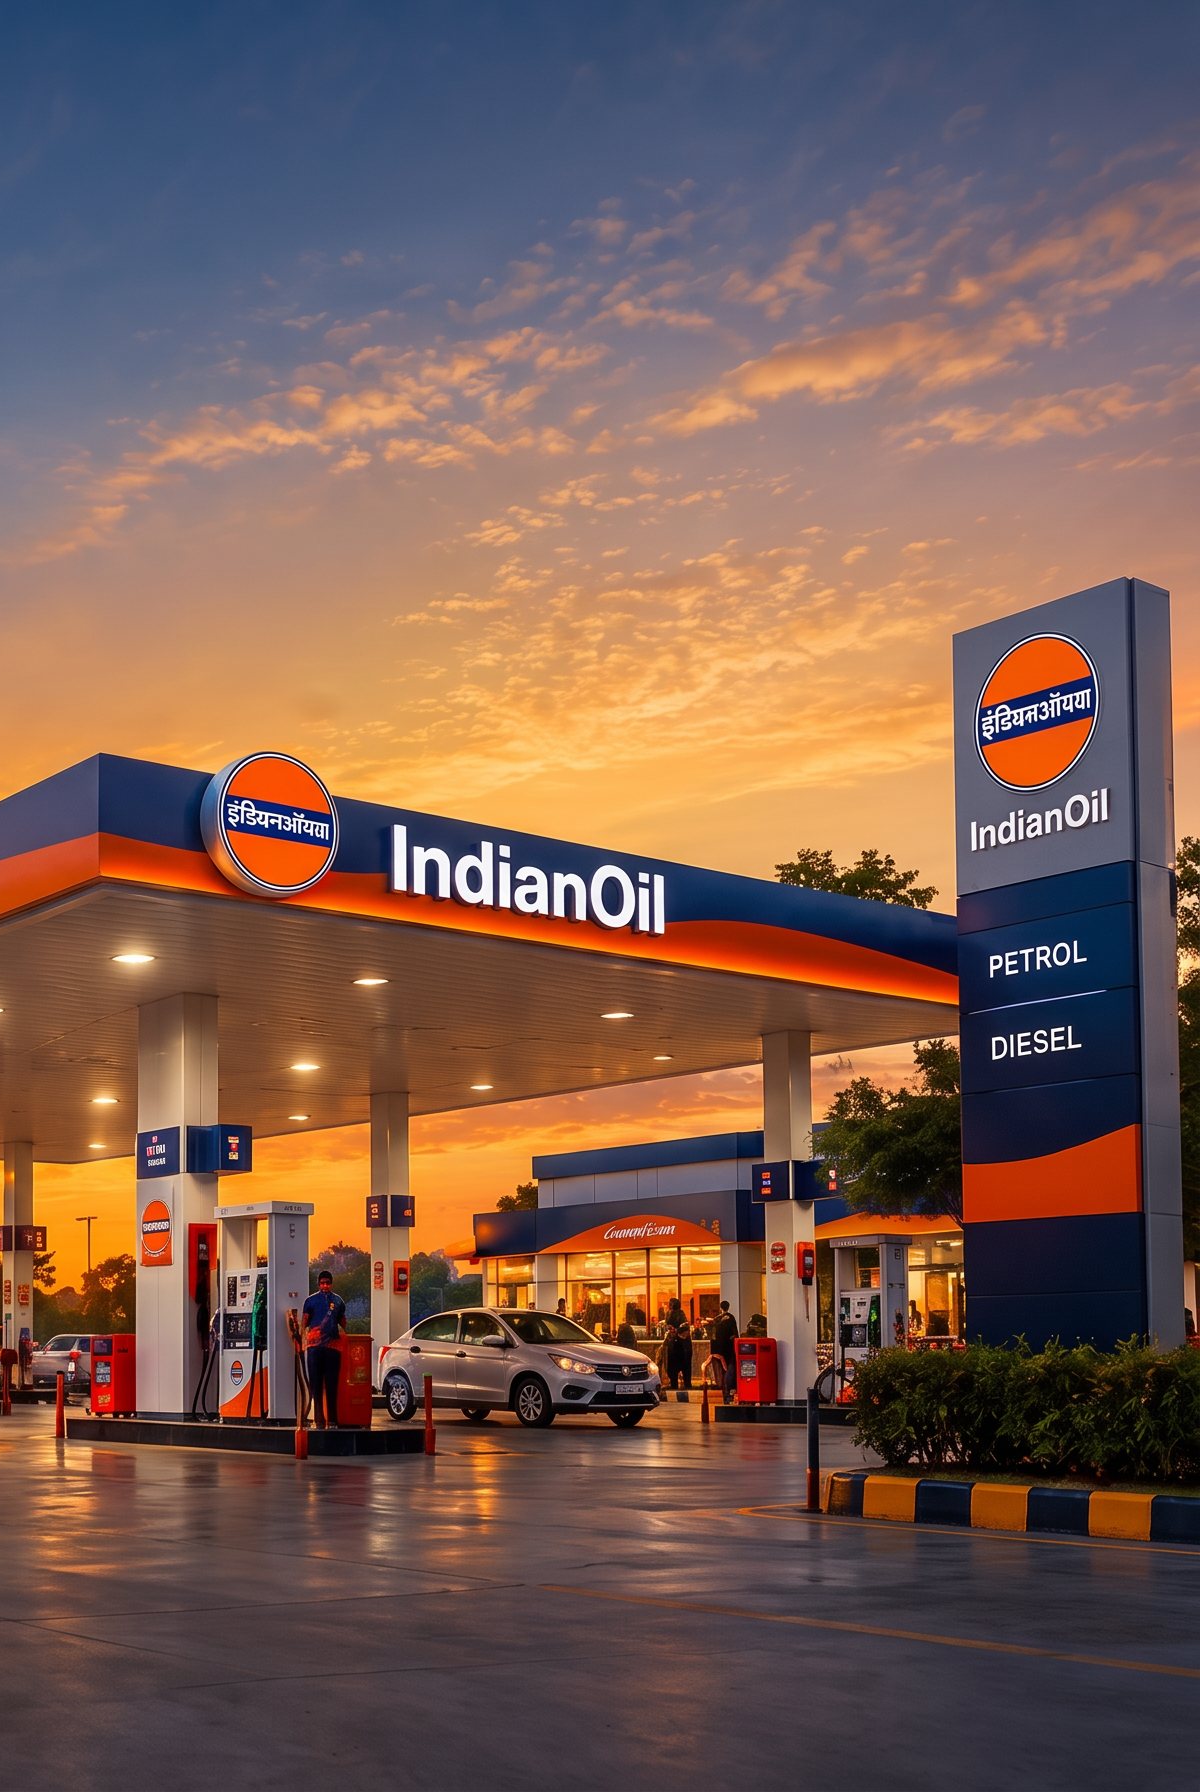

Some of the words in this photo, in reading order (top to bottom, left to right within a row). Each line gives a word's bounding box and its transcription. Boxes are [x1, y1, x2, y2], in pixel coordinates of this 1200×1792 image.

[971, 787, 1109, 852] IndianOil
[392, 824, 665, 935] IndianOil
[989, 940, 1088, 979] PETROL
[991, 1025, 1082, 1061] DIESEL
